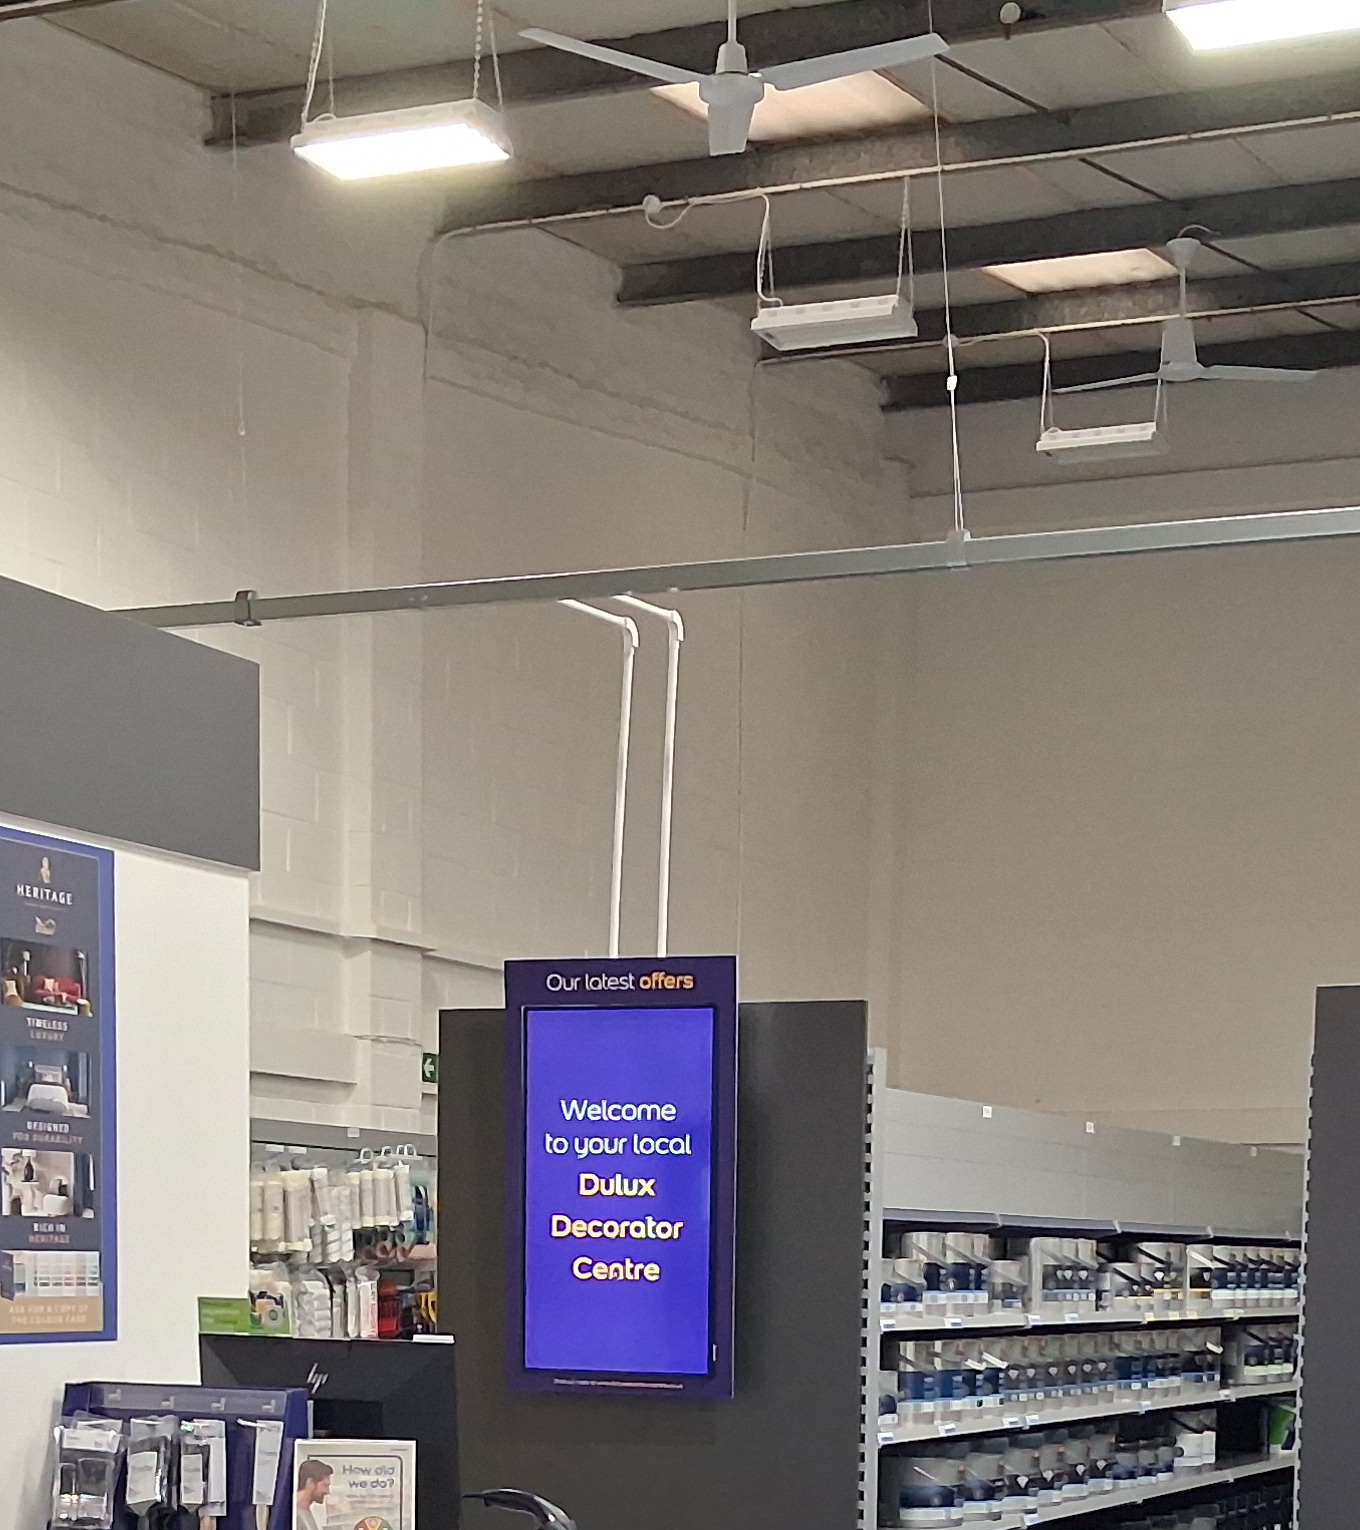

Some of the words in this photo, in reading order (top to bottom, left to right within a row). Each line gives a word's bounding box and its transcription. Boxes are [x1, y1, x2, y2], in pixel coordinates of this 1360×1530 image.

[16, 883, 73, 905] HERITAGE
[545, 972, 582, 993] Our
[585, 971, 636, 992] latest
[638, 970, 695, 991] offers
[559, 1099, 677, 1122] Welcome
[544, 1132, 569, 1155] to
[574, 1134, 628, 1159] your
[632, 1132, 693, 1156] local
[578, 1173, 657, 1198] Dulux
[551, 1213, 685, 1241] Decorator
[572, 1255, 661, 1283] Centre
[342, 1464, 371, 1476] How
[373, 1463, 396, 1476] did
[348, 1478, 367, 1489] we
[370, 1477, 396, 1489] do?
